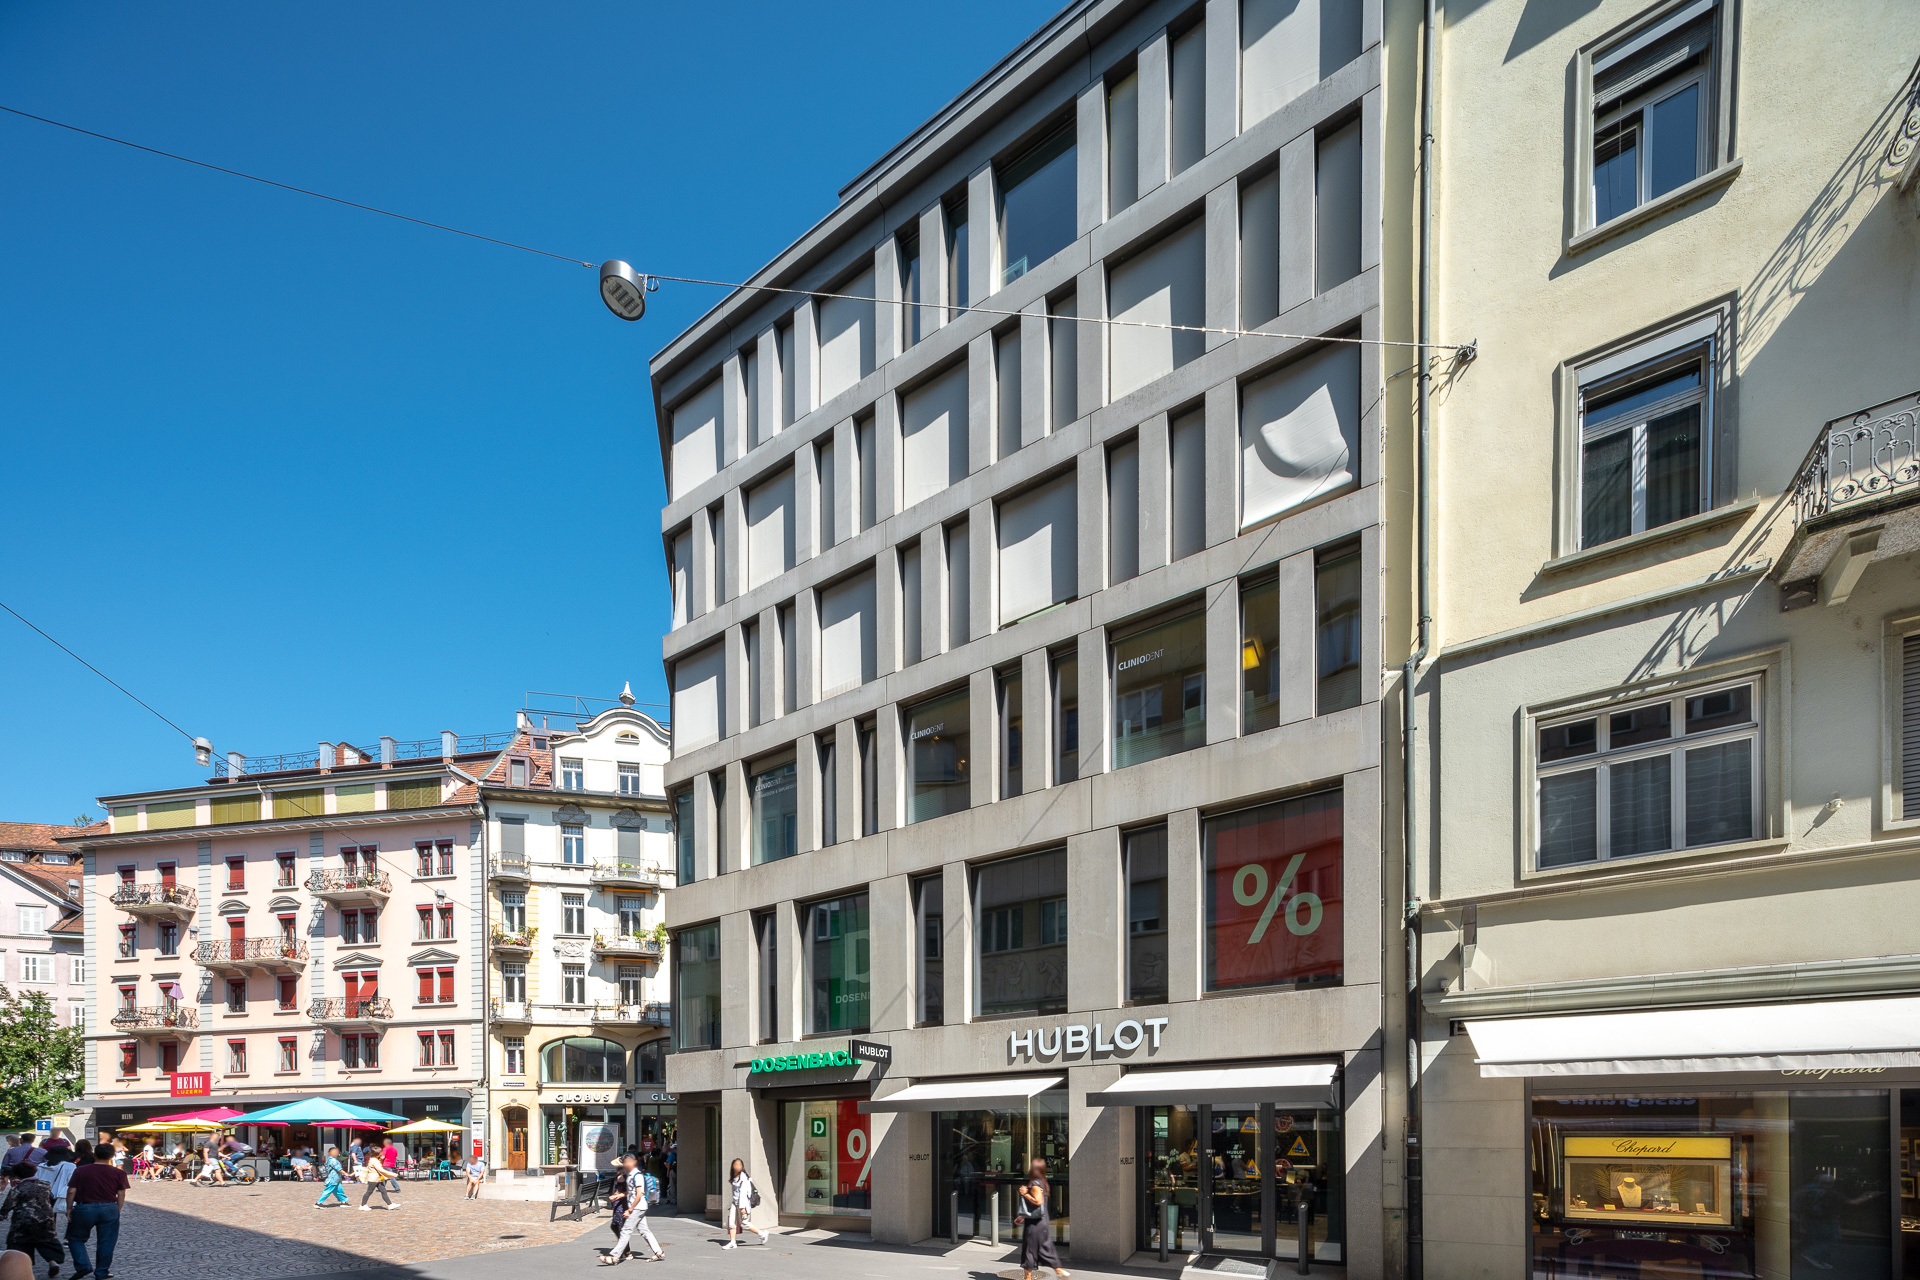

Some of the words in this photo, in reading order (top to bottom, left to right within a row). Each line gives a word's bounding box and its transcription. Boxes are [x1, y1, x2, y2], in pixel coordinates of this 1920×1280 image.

[1118, 648, 1164, 671] CLINIODENT
[910, 722, 944, 740] CLINIODENT
[835, 991, 870, 1004] DOSEN
[1011, 1017, 1169, 1058] HUBLOT
[859, 1045, 889, 1058] HUBLOT
[176, 1076, 203, 1089] HEINI
[555, 1093, 610, 1102] GLOBUS
[814, 1120, 824, 1134] D
[1612, 1139, 1677, 1156] Chopard
[1120, 1156, 1135, 1165] HUBLOT
